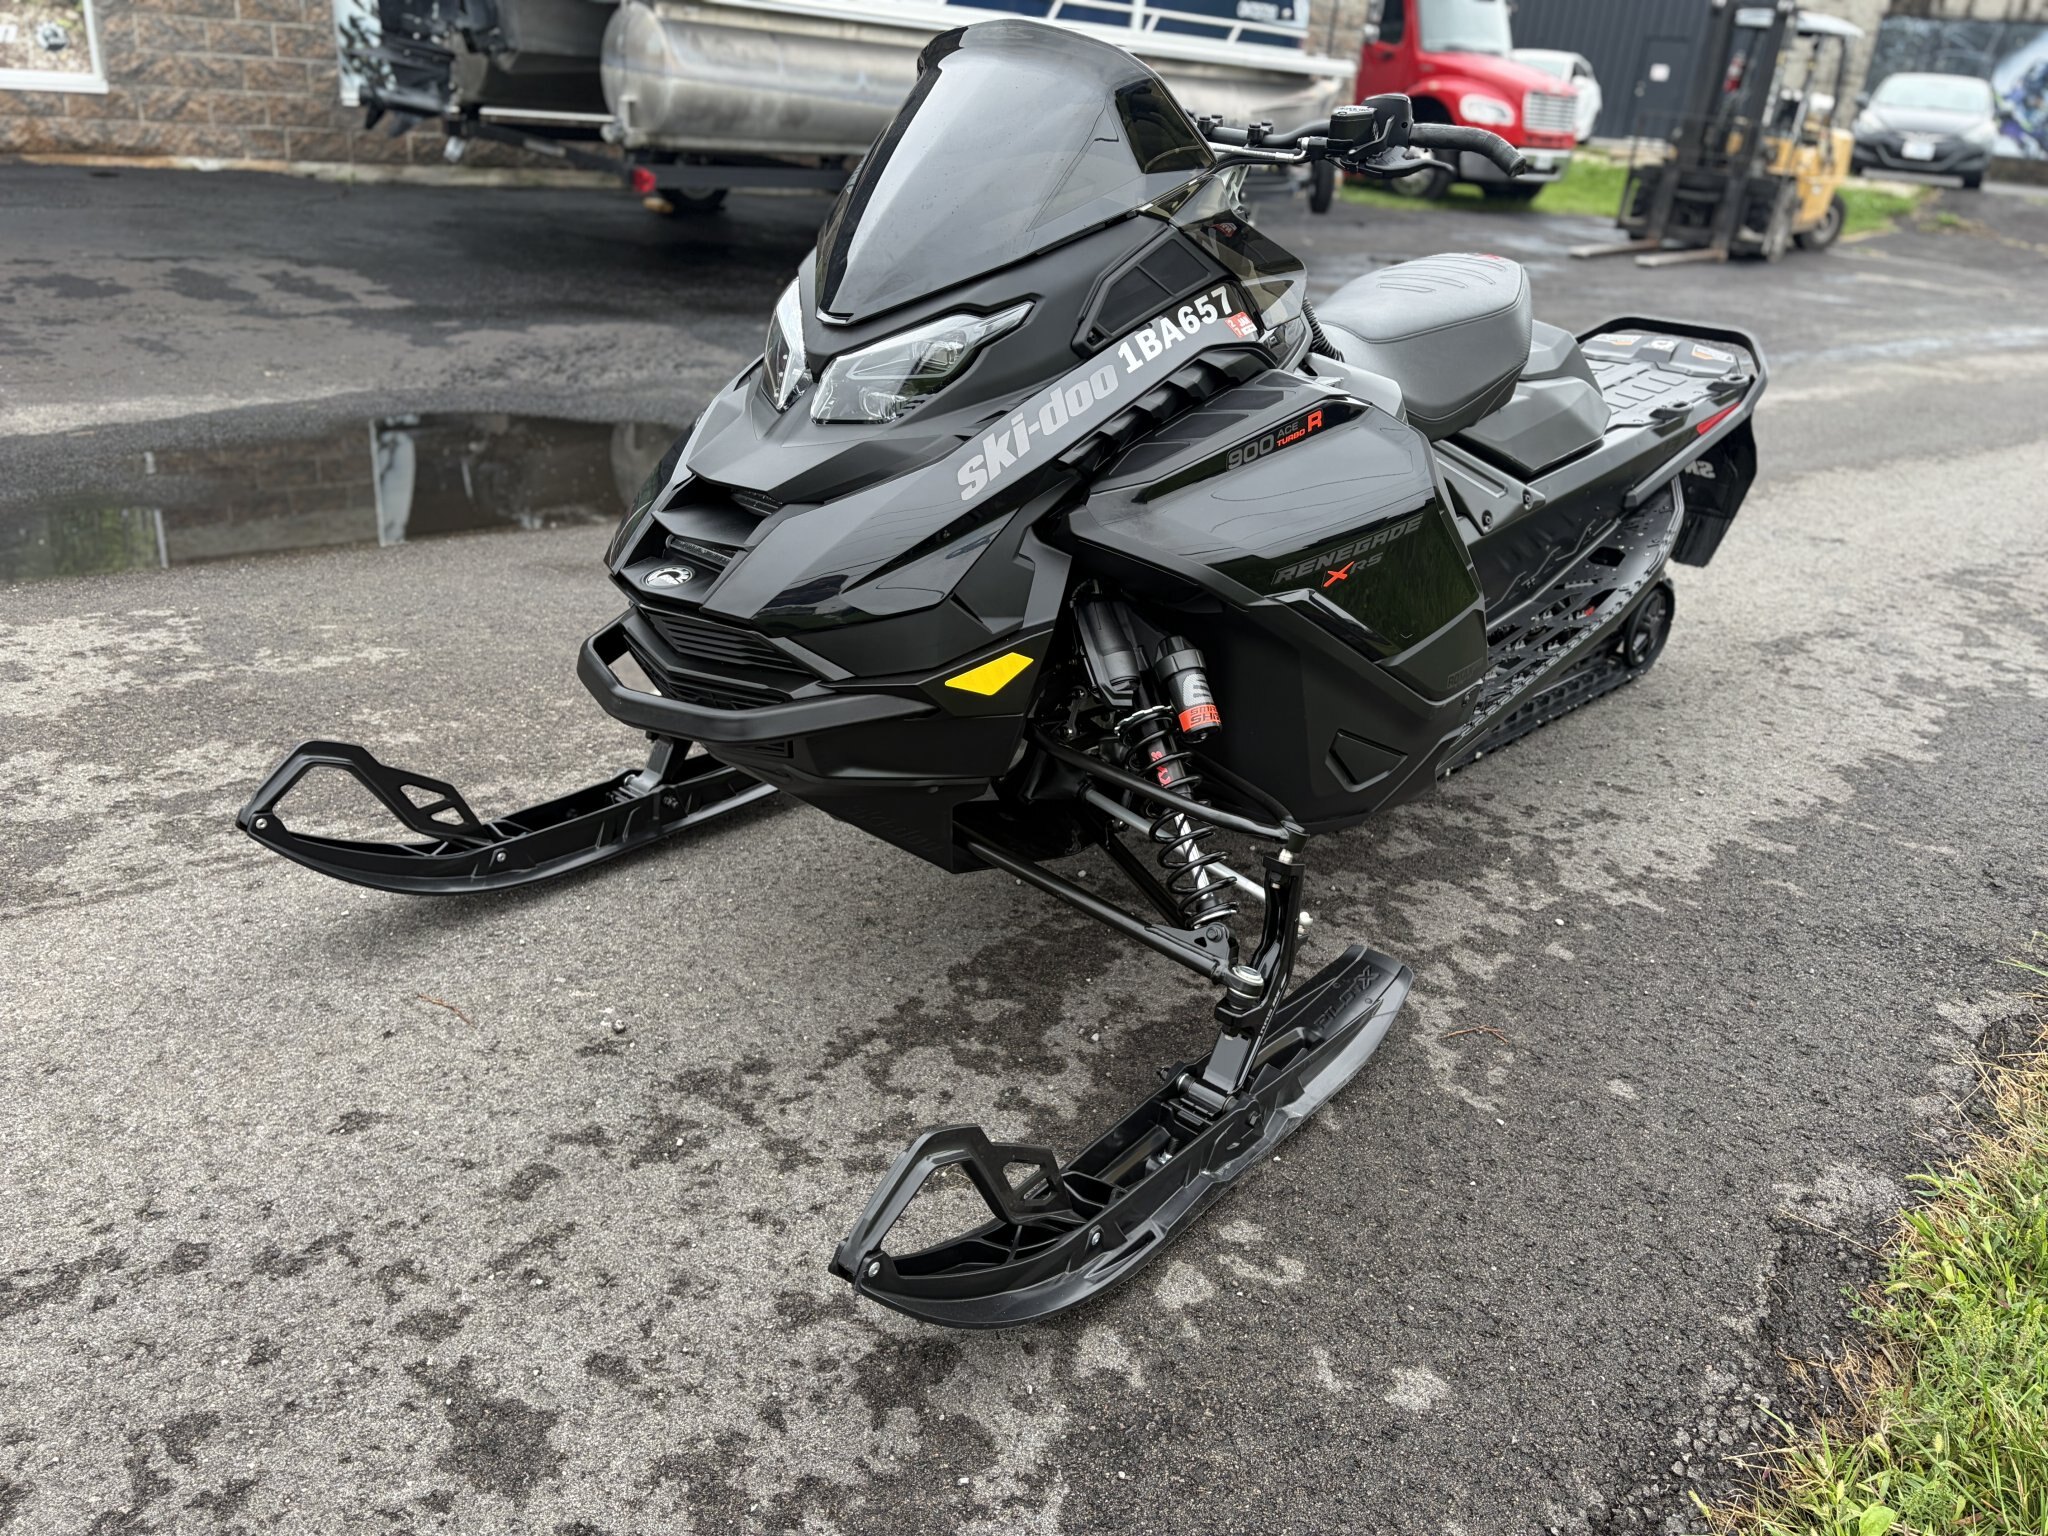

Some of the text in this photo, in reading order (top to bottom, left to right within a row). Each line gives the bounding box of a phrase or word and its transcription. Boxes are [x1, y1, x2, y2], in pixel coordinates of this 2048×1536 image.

[1118, 285, 1232, 374] 1BA657
[1228, 421, 1299, 470] 900 ACE
[1276, 410, 1322, 447] TURBO R
[1273, 514, 1424, 585] RENEGADE
